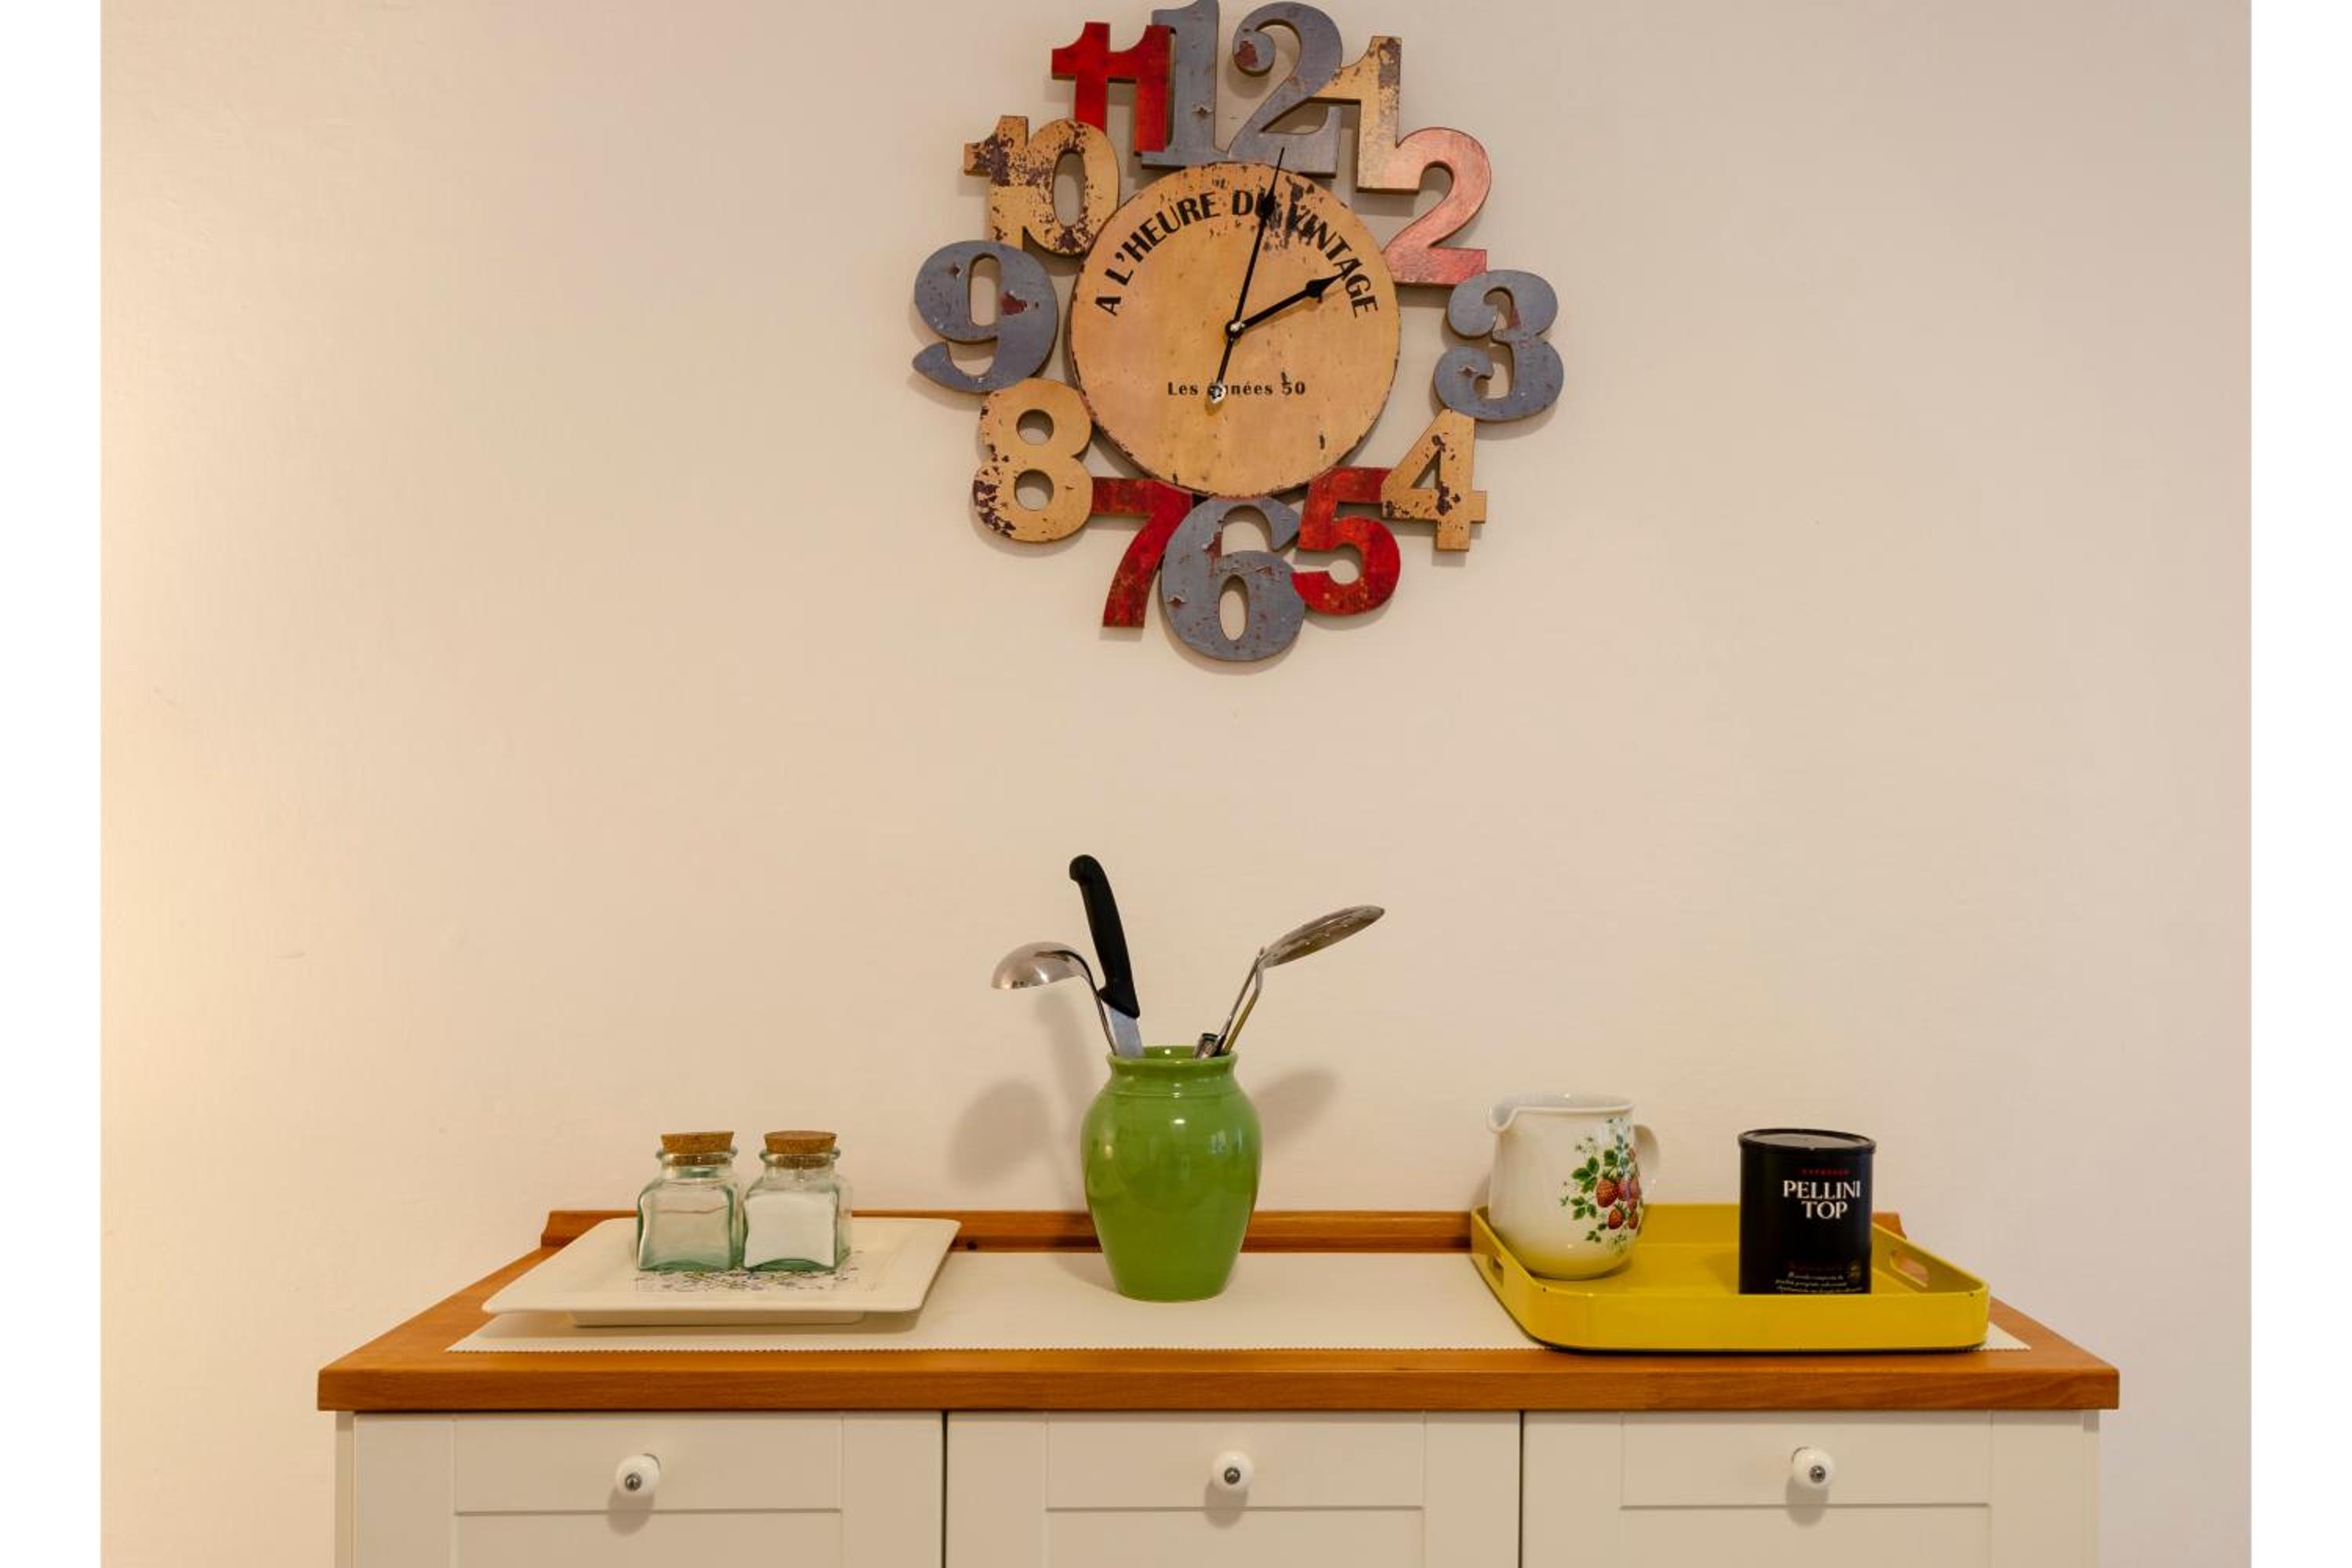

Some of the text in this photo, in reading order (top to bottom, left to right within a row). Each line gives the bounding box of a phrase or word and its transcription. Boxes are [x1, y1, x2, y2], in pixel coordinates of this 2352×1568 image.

[1051, 22, 1171, 152] 11
[1142, 0, 1344, 174] 12
[1322, 36, 1403, 191] 1
[964, 115, 1120, 256] 10
[1104, 191, 1221, 286] L'HEURE
[1385, 127, 1493, 285] 2
[913, 240, 1058, 393] 9
[1094, 296, 1122, 317] A
[1434, 270, 1564, 422] 3
[973, 378, 1093, 543] 8
[1167, 379, 1306, 396] Les nées 50
[1092, 477, 1195, 628] 7
[1292, 466, 1402, 616] 5
[1382, 409, 1487, 552] 4
[1160, 497, 1306, 662] 6
[1783, 1180, 1860, 1199] PELLINI
[1801, 1200, 1848, 1219] TOP
